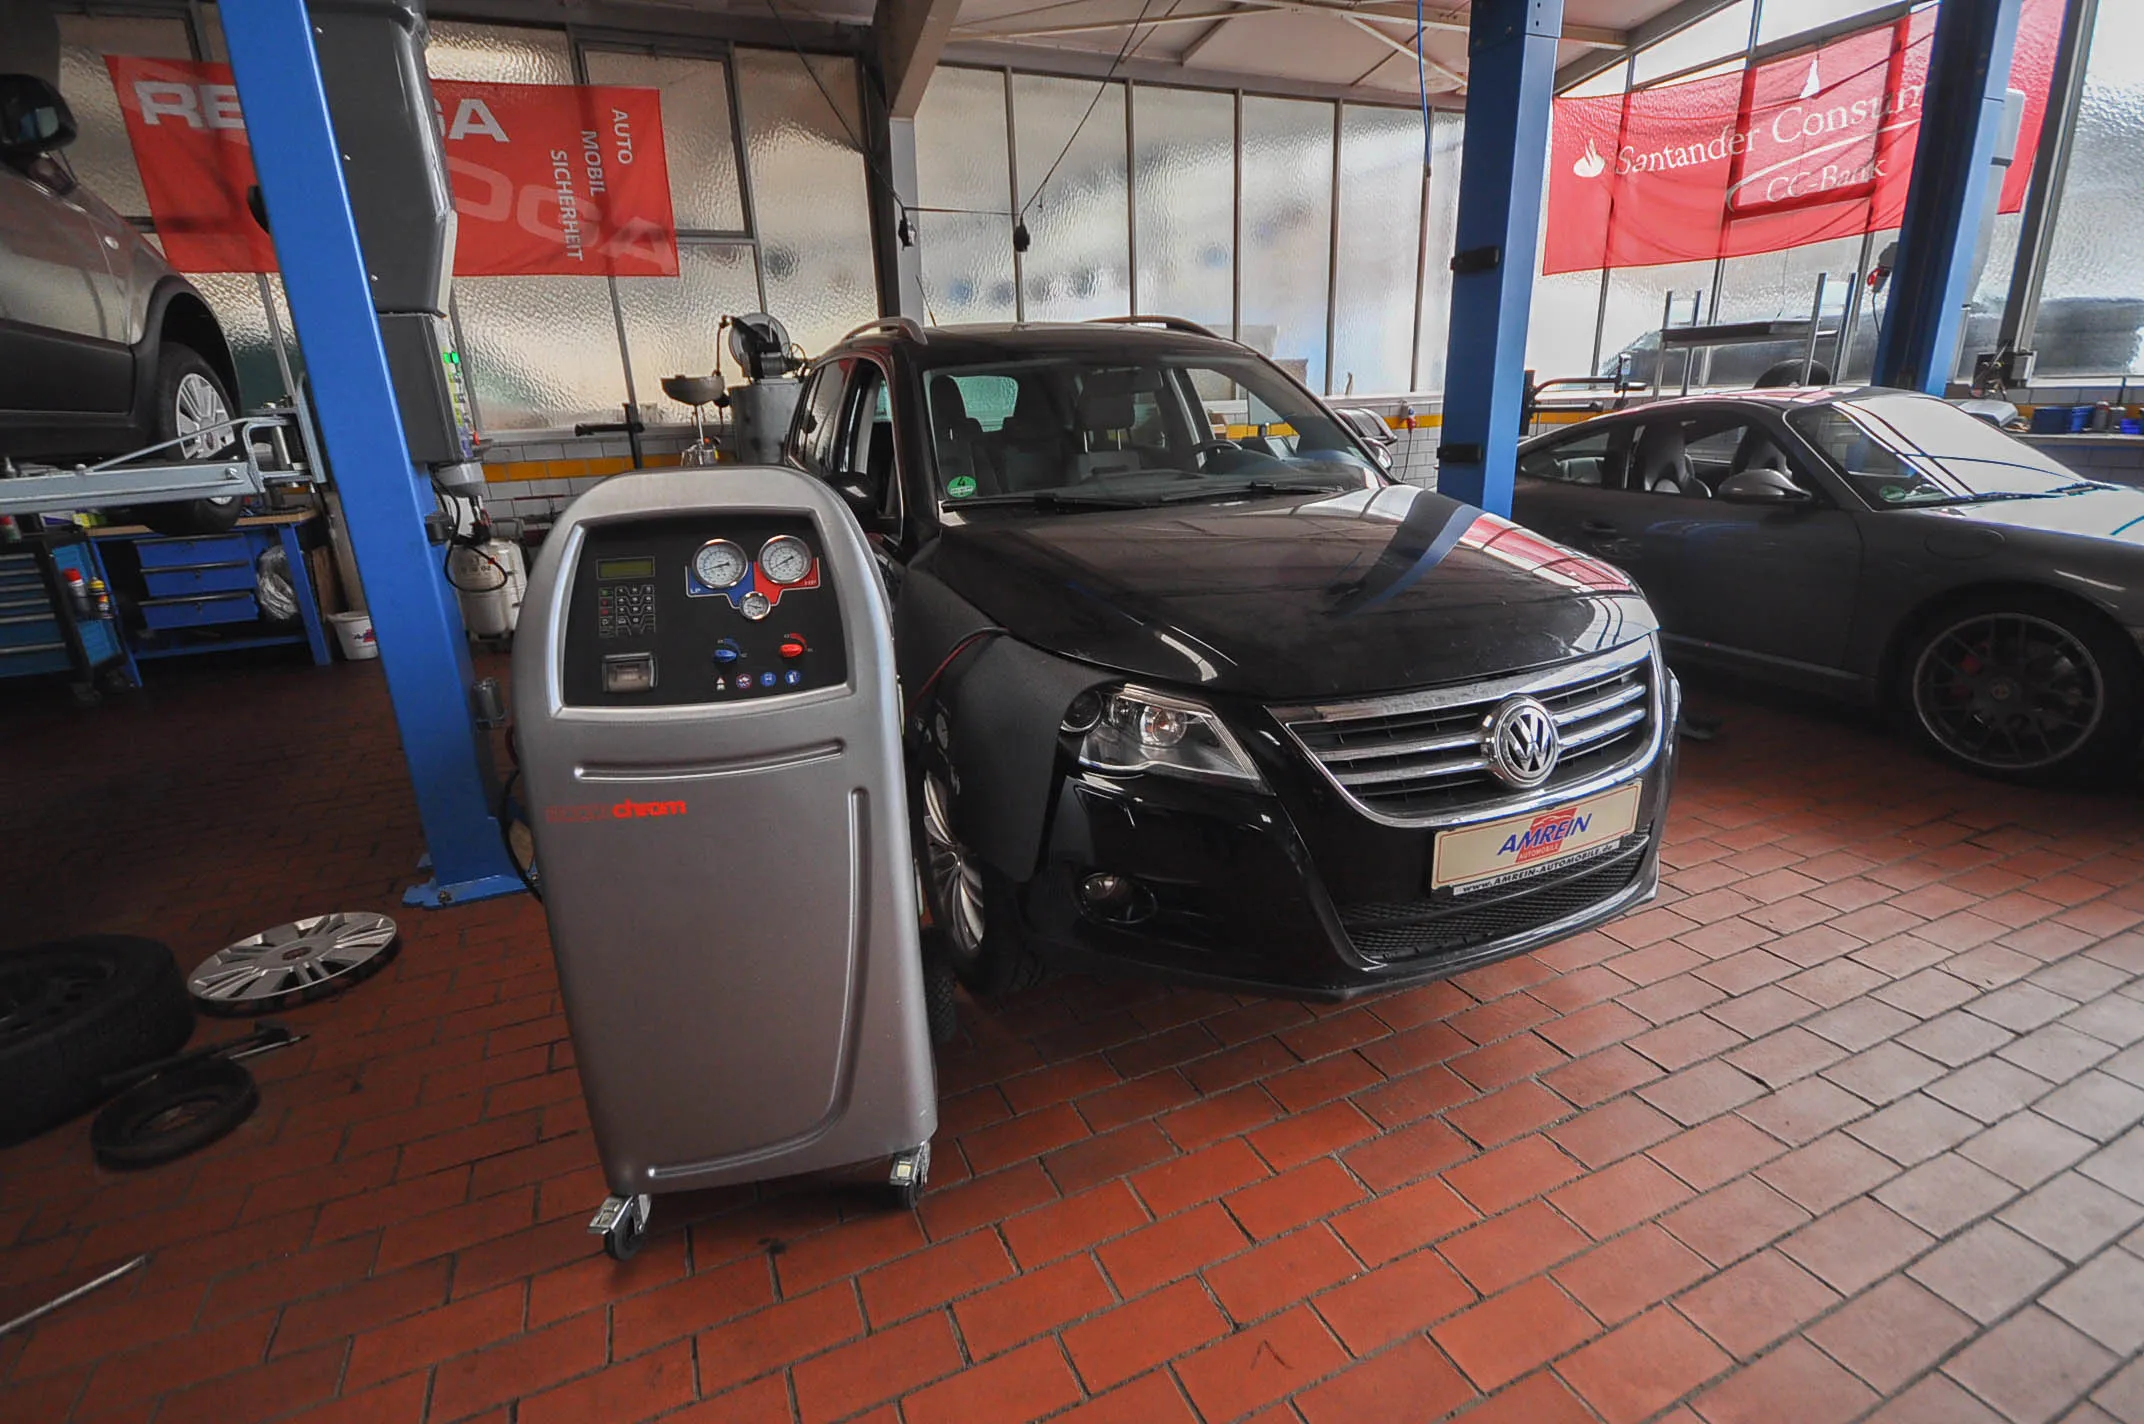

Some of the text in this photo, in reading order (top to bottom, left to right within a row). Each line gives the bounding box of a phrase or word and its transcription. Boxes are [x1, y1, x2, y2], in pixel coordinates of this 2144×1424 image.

[611, 108, 633, 165] AUTO
[1615, 124, 1760, 175] Santander
[580, 129, 606, 197] MOBIL
[1767, 153, 1888, 203] CC-Bank
[551, 149, 584, 262] SICHERHEIT
[690, 587, 702, 595] LP
[1497, 813, 1592, 856] AMREIN
[1519, 843, 1560, 860] AUTOMOBILE
